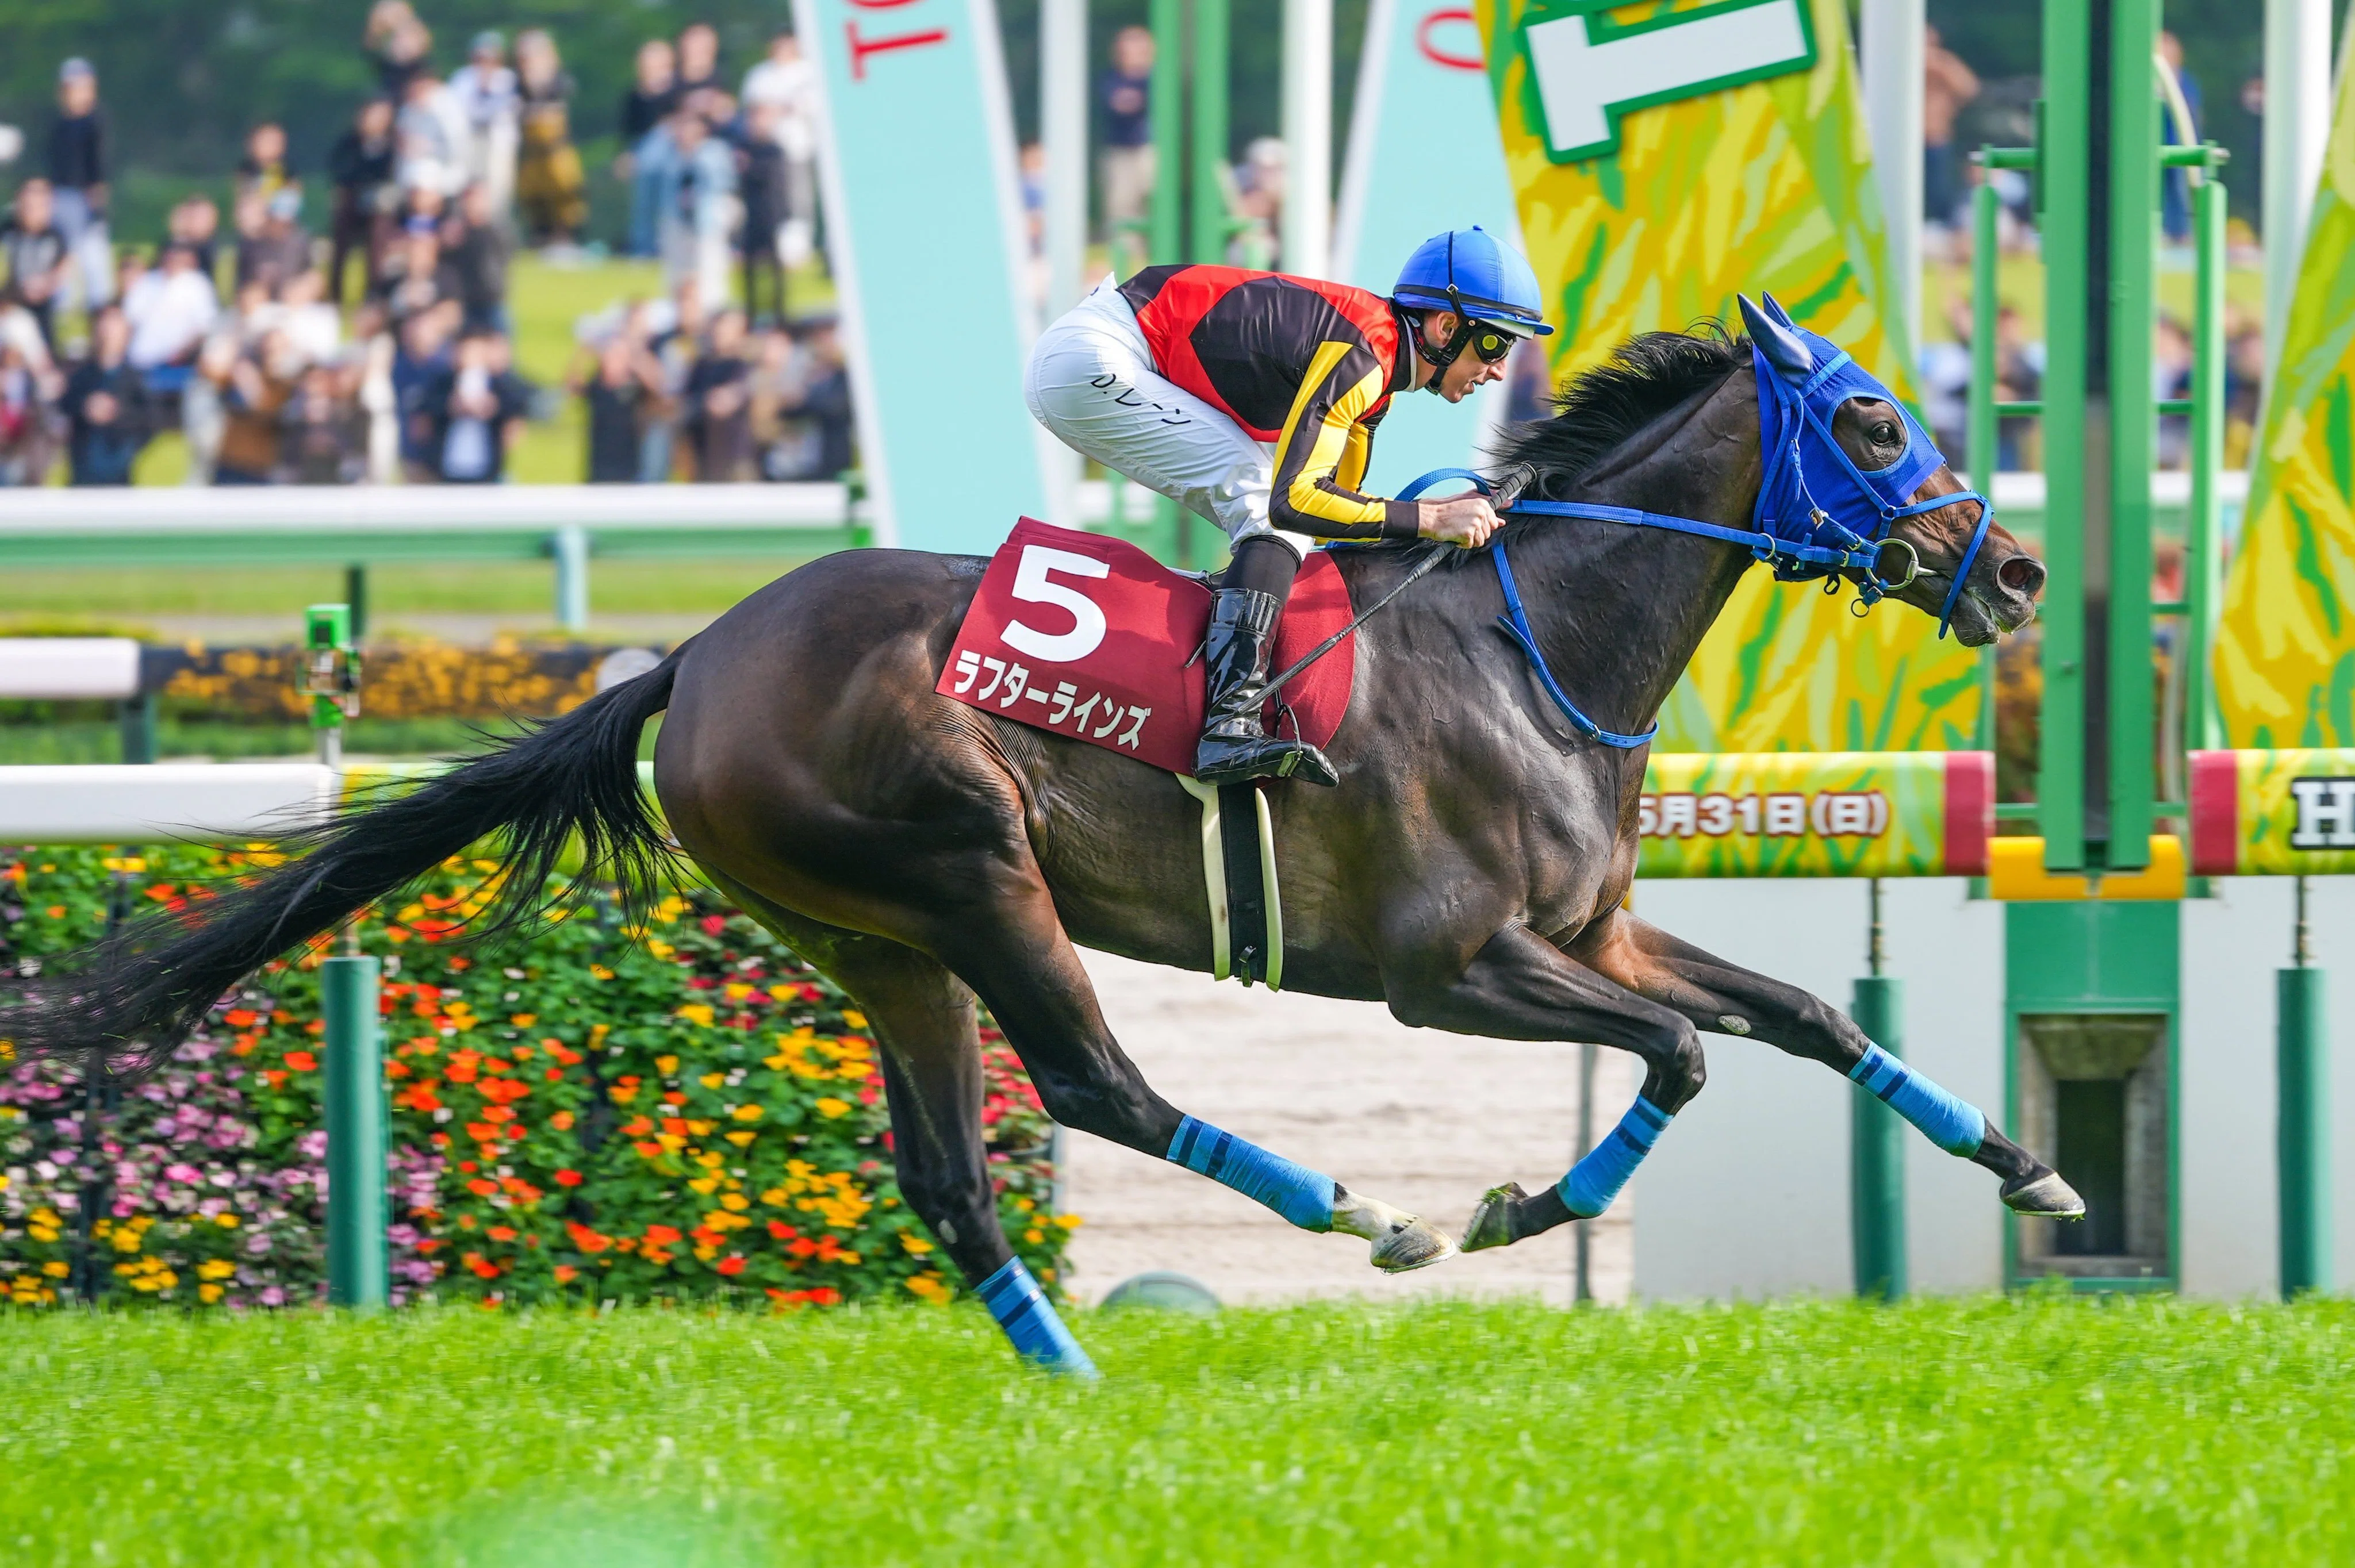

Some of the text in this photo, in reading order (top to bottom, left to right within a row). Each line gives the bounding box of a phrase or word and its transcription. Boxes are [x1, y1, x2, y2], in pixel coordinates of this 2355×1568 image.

[846, 0, 946, 80] T
[1000, 544, 1110, 662] 5
[953, 650, 1152, 751] ラフターラインズ
[2292, 781, 2355, 846] H
